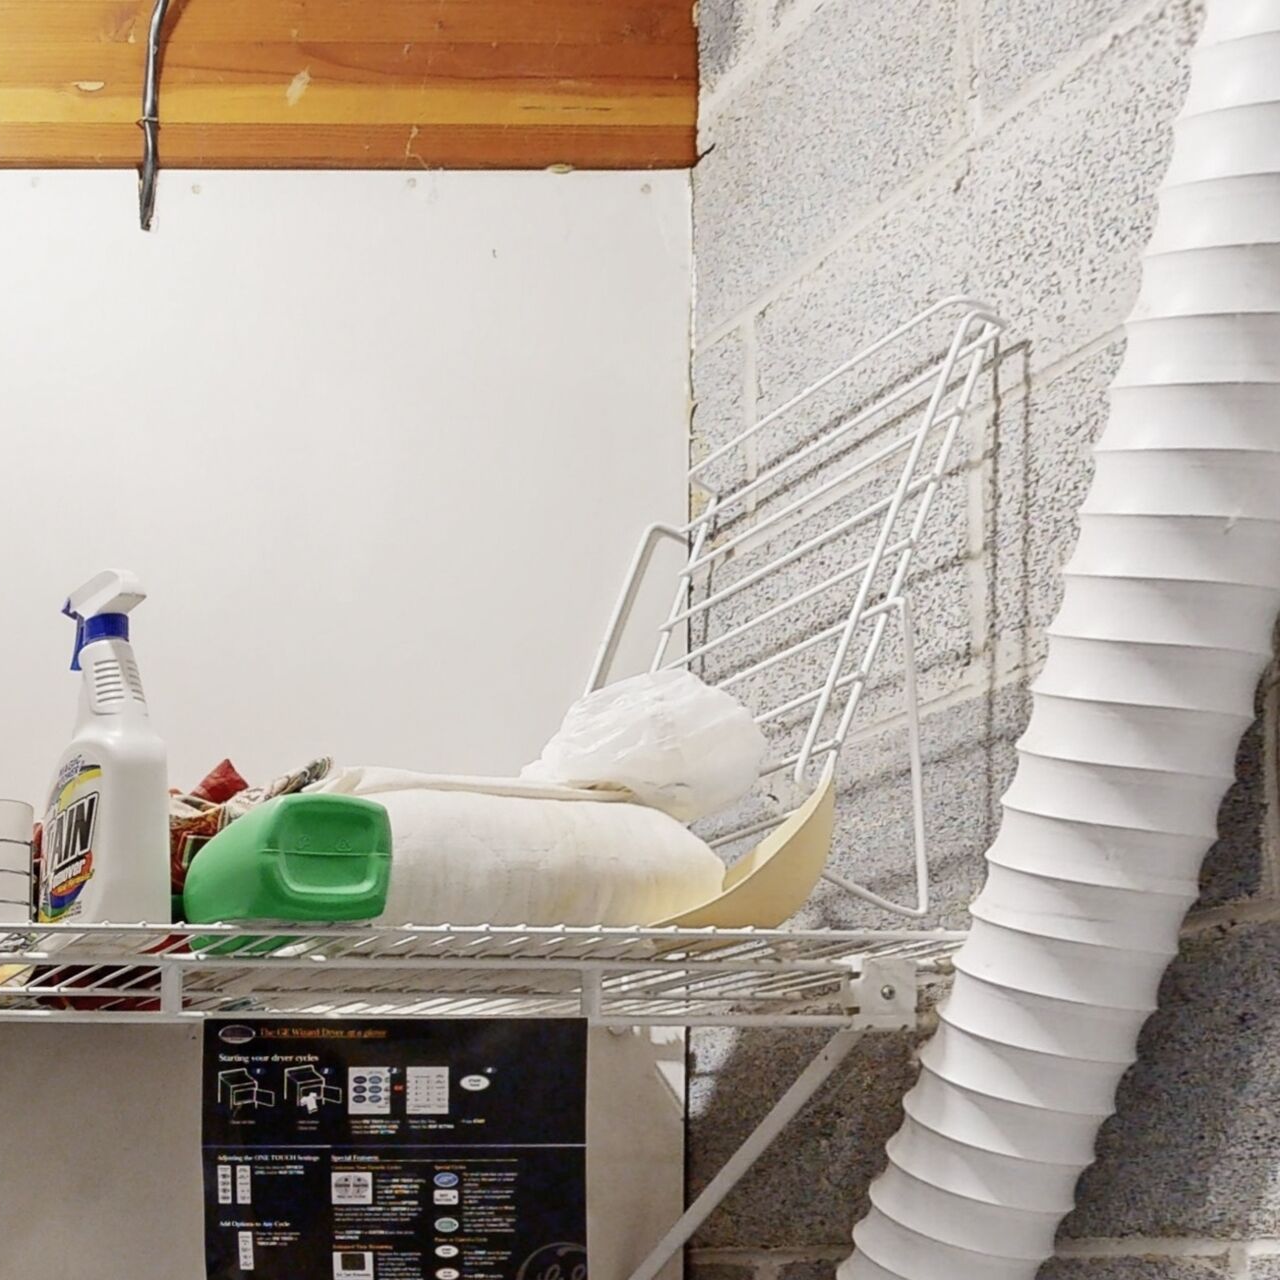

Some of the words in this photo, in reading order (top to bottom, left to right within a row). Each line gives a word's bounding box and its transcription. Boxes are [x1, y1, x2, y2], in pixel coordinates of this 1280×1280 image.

[46, 791, 99, 872] TAIN
[218, 1054, 250, 1063] Starting
[271, 1054, 293, 1062] dryer
[295, 1054, 319, 1062] cycles
